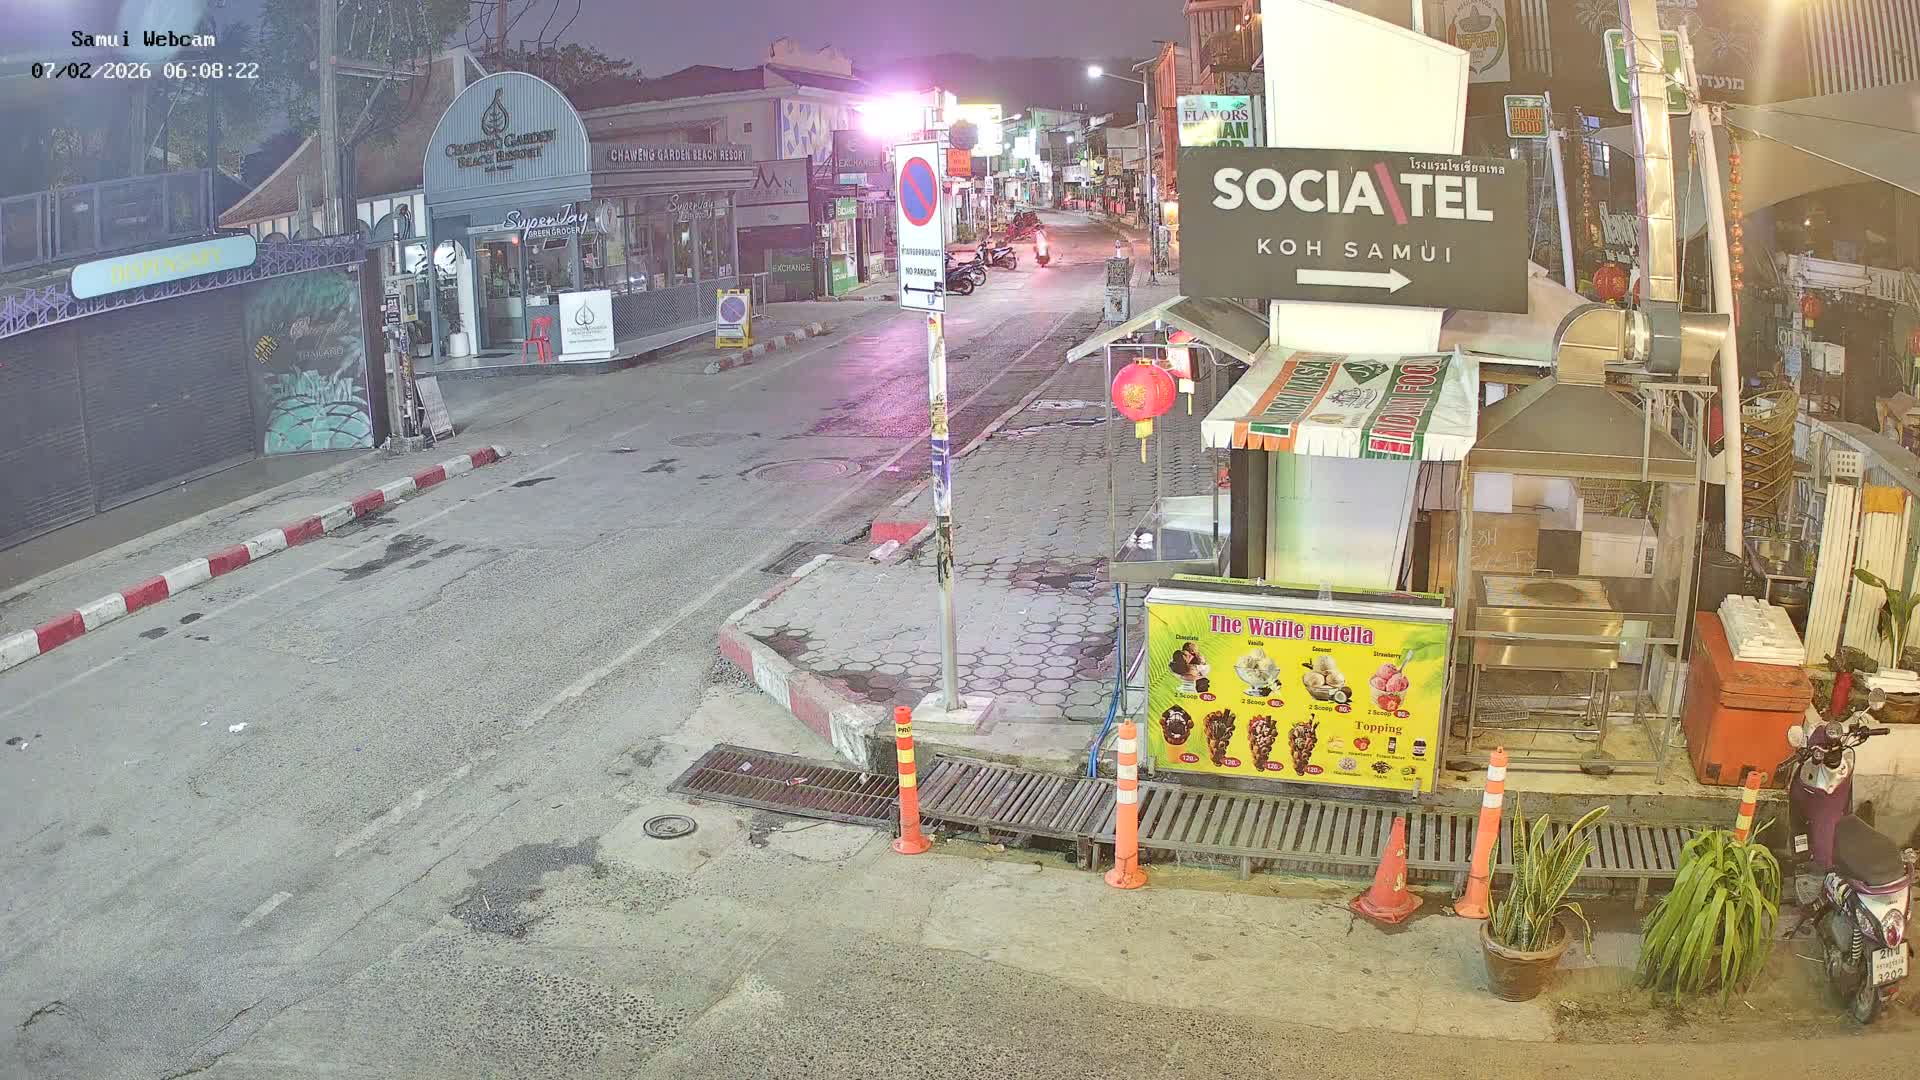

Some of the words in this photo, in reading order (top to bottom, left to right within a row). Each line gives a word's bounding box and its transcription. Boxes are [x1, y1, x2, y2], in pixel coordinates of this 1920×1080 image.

[1184, 109, 1249, 122] FLAVORS
[1511, 120, 1542, 135] FOOD
[611, 148, 655, 162] CHAWENG
[657, 149, 691, 161] GARDEN
[693, 149, 718, 161] BEACH
[720, 149, 746, 161] RESORT
[839, 159, 879, 169] EXCHANGE
[528, 229, 551, 239] GREEN
[551, 226, 581, 236] GROCER
[1256, 238, 1323, 257] KOH
[1344, 240, 1451, 264] SAMUI
[111, 247, 224, 286] DISPENSARY
[772, 263, 811, 273] EXCHANGE
[905, 266, 914, 276] NO
[914, 267, 937, 278] PARKING
[299, 346, 344, 361] THAILAND
[1208, 614, 1243, 634] The
[1247, 617, 1305, 640] Waffle
[1309, 623, 1376, 646] nutella
[1373, 651, 1402, 660] Strawberry
[1354, 720, 1403, 736] Topping
